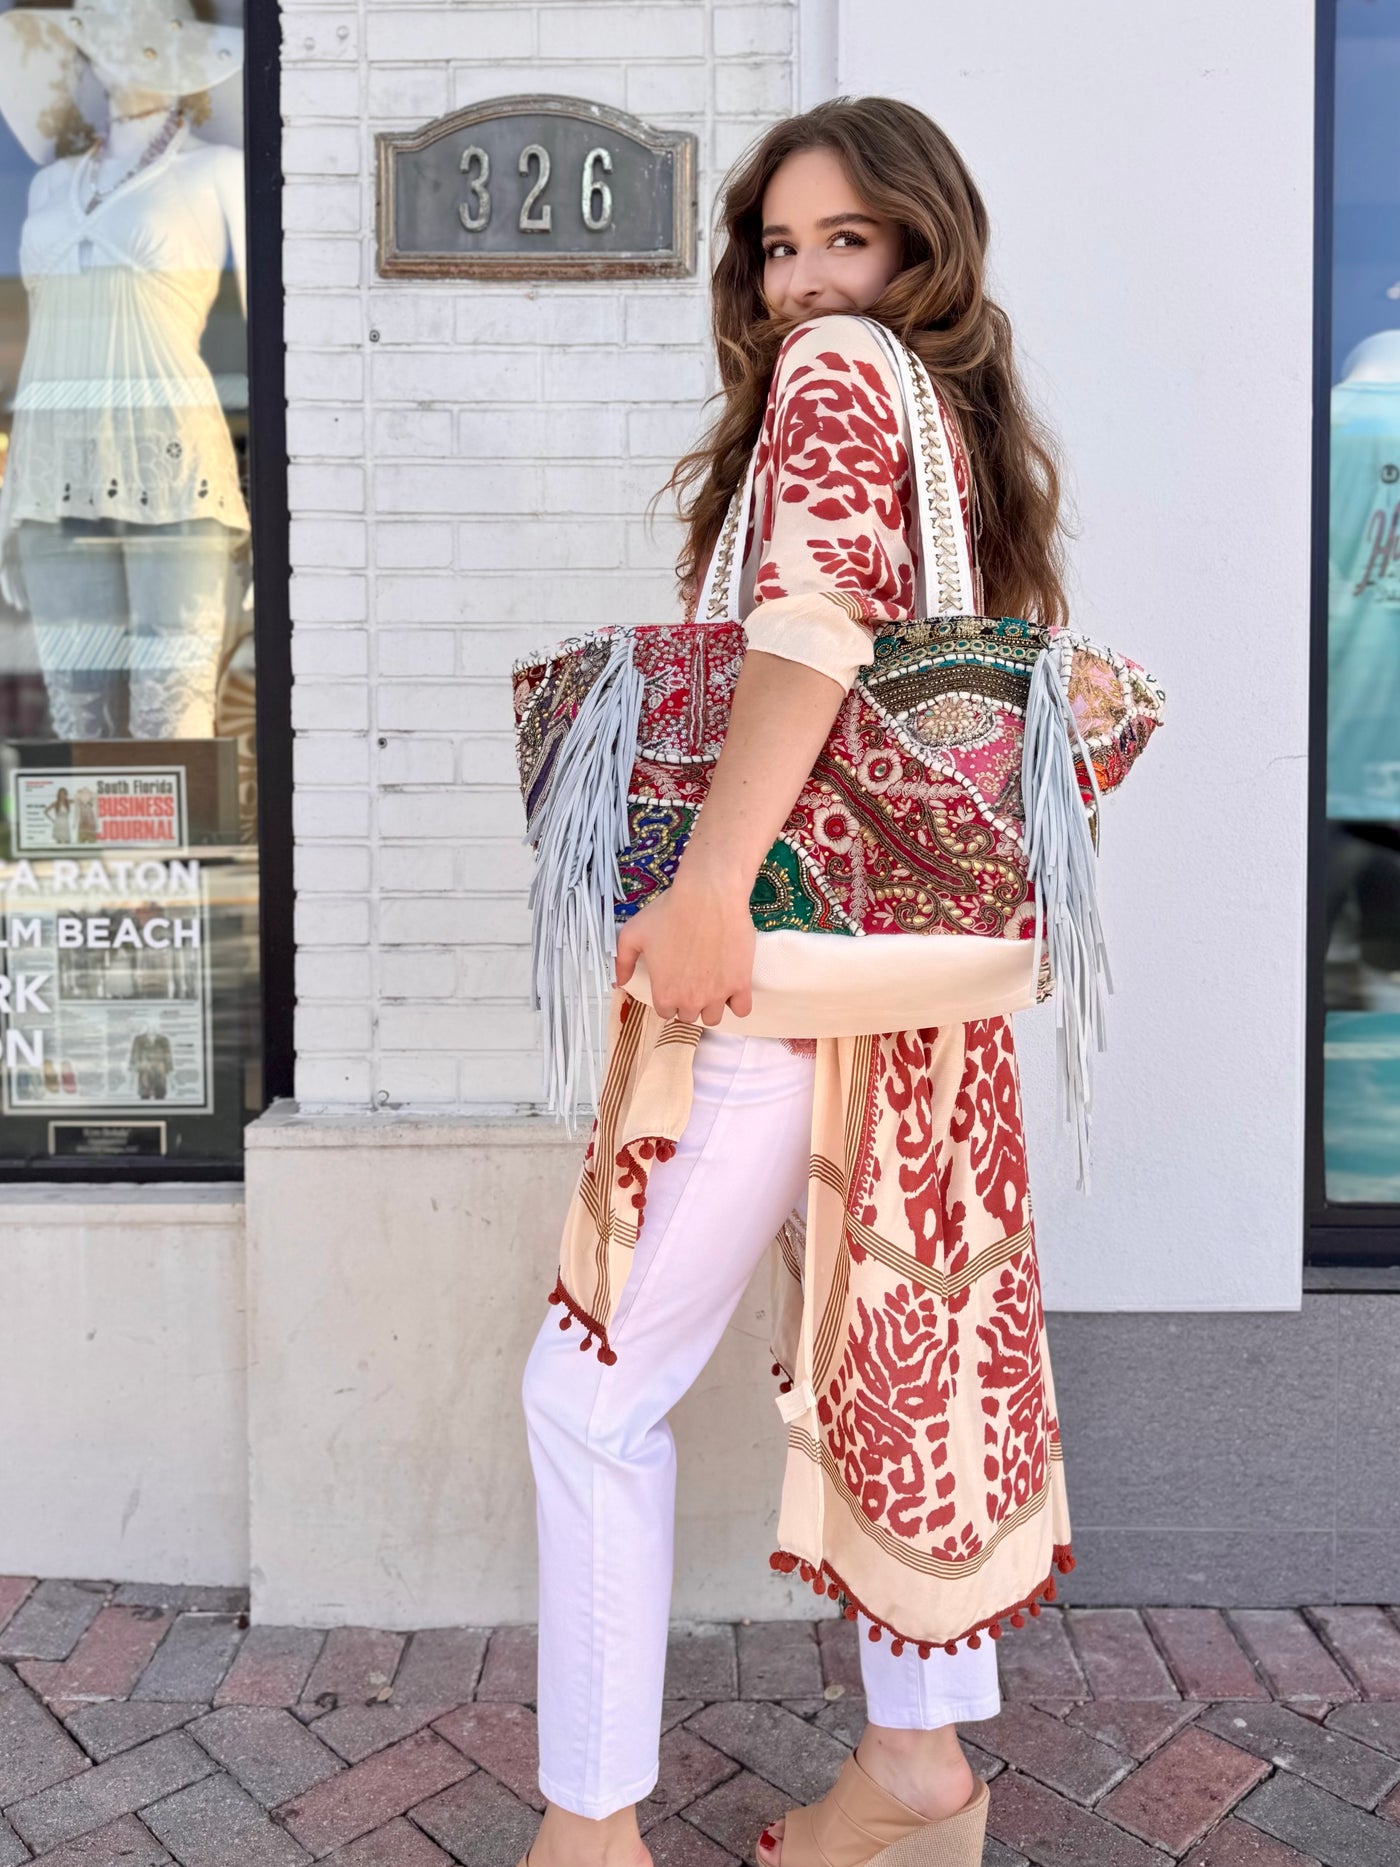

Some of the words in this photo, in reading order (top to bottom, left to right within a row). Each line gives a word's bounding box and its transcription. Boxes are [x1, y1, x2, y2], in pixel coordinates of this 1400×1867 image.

[458, 143, 614, 233] 326
[96, 780, 130, 795] South
[133, 779, 174, 795] Florida
[97, 796, 175, 817] BUSINESS
[96, 819, 175, 841] JOURNAL
[0, 859, 39, 891] A
[53, 859, 201, 891] RATON
[58, 918, 201, 948] BEACH
[0, 1029, 44, 1069] N
